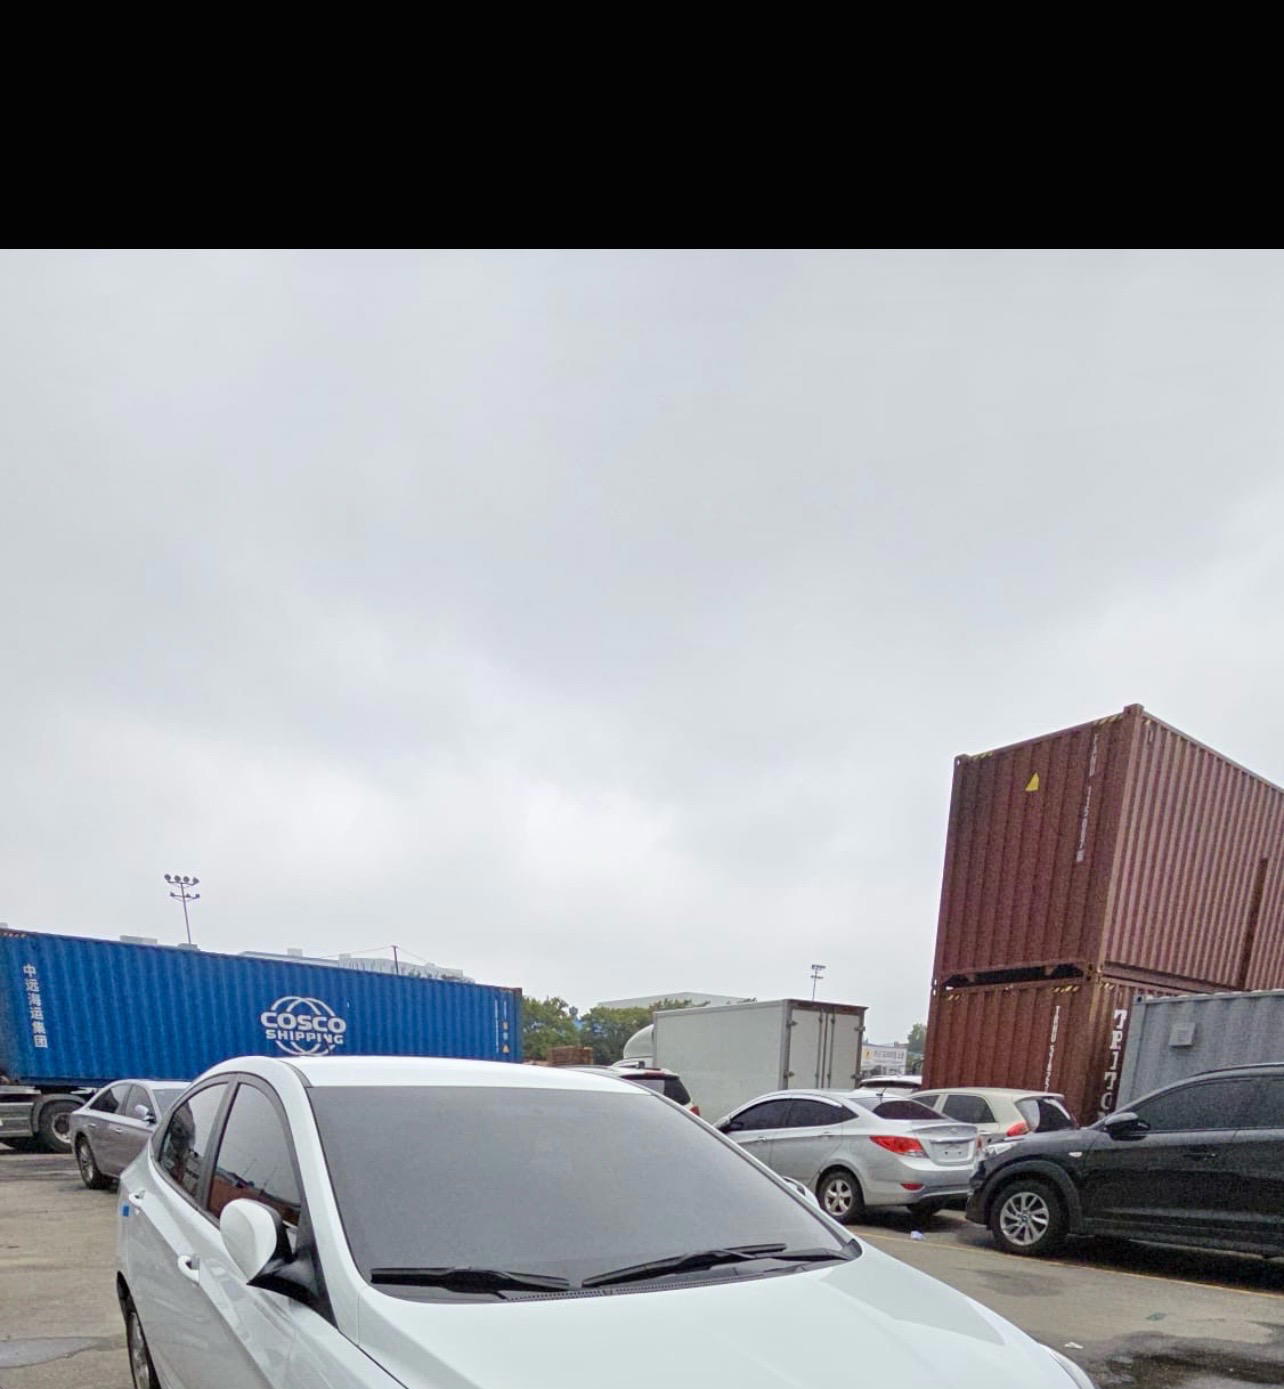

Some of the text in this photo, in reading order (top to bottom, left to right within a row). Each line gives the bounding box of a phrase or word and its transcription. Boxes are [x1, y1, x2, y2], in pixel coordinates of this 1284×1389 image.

[260, 1011, 347, 1034] COSCO
[265, 1029, 344, 1045] SHIPPING
[1098, 1009, 1128, 1119] TRITO
